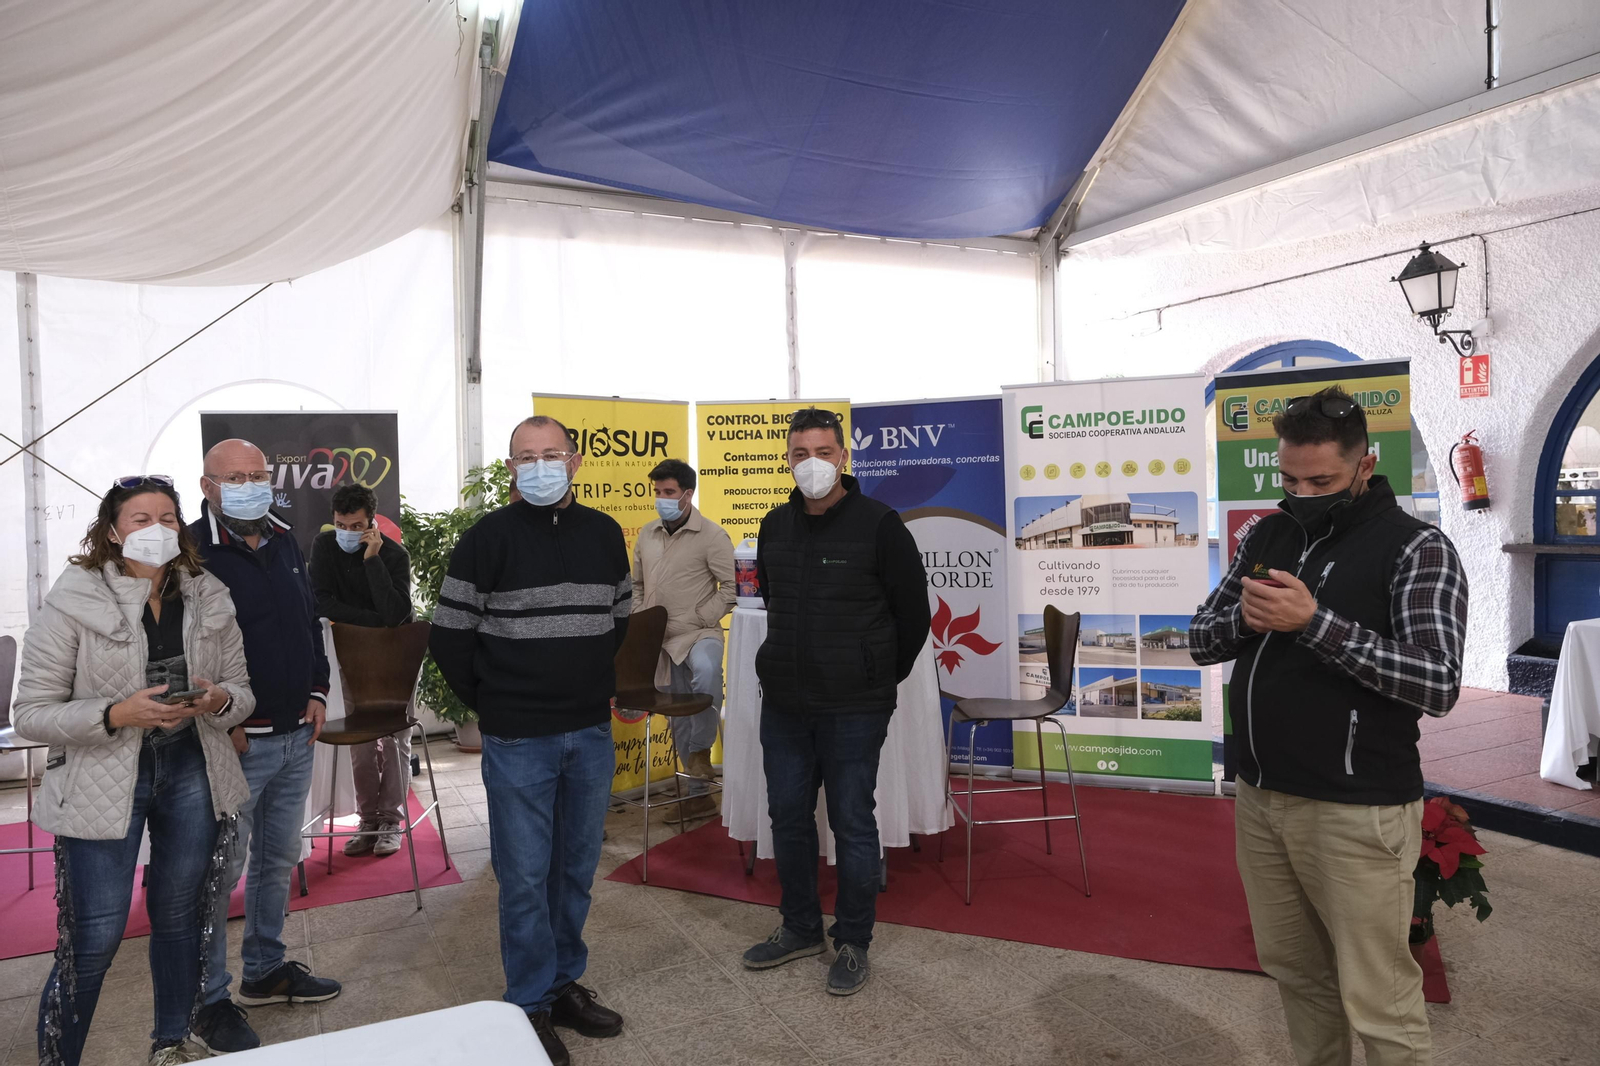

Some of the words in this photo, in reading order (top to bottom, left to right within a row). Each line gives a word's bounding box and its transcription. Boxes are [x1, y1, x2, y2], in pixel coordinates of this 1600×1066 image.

[706, 414, 769, 426] CONTROL
[1048, 408, 1186, 430] CAMPOEJIDO
[706, 431, 716, 441] Y
[719, 429, 764, 440] LUCHA
[880, 424, 946, 450] BNV
[1048, 431, 1087, 440] SOCIEDAD
[1088, 428, 1142, 438] COOPERATIVA
[1143, 426, 1186, 435] ANDALUZA
[276, 453, 307, 463] Export
[723, 452, 779, 462] Contamos
[851, 459, 897, 468] Soluciones
[899, 457, 954, 466] innovadoras,
[955, 454, 1000, 463] concretas
[700, 466, 739, 477] amplia
[742, 465, 777, 475] gama
[858, 468, 900, 477] rentables.
[1253, 473, 1265, 493] y
[572, 483, 652, 499] TRIP-SOI
[723, 488, 772, 496] PRODUCTOS
[624, 502, 657, 511] robustu
[1233, 513, 1262, 540] NUEVA
[1038, 560, 1101, 570] Cultivando
[925, 571, 994, 588] ORDE
[1045, 573, 1055, 583] el
[1058, 573, 1094, 583] futuro
[1040, 586, 1074, 596] desde
[1077, 586, 1100, 596] 1979
[1026, 672, 1050, 681] CAMPOE
